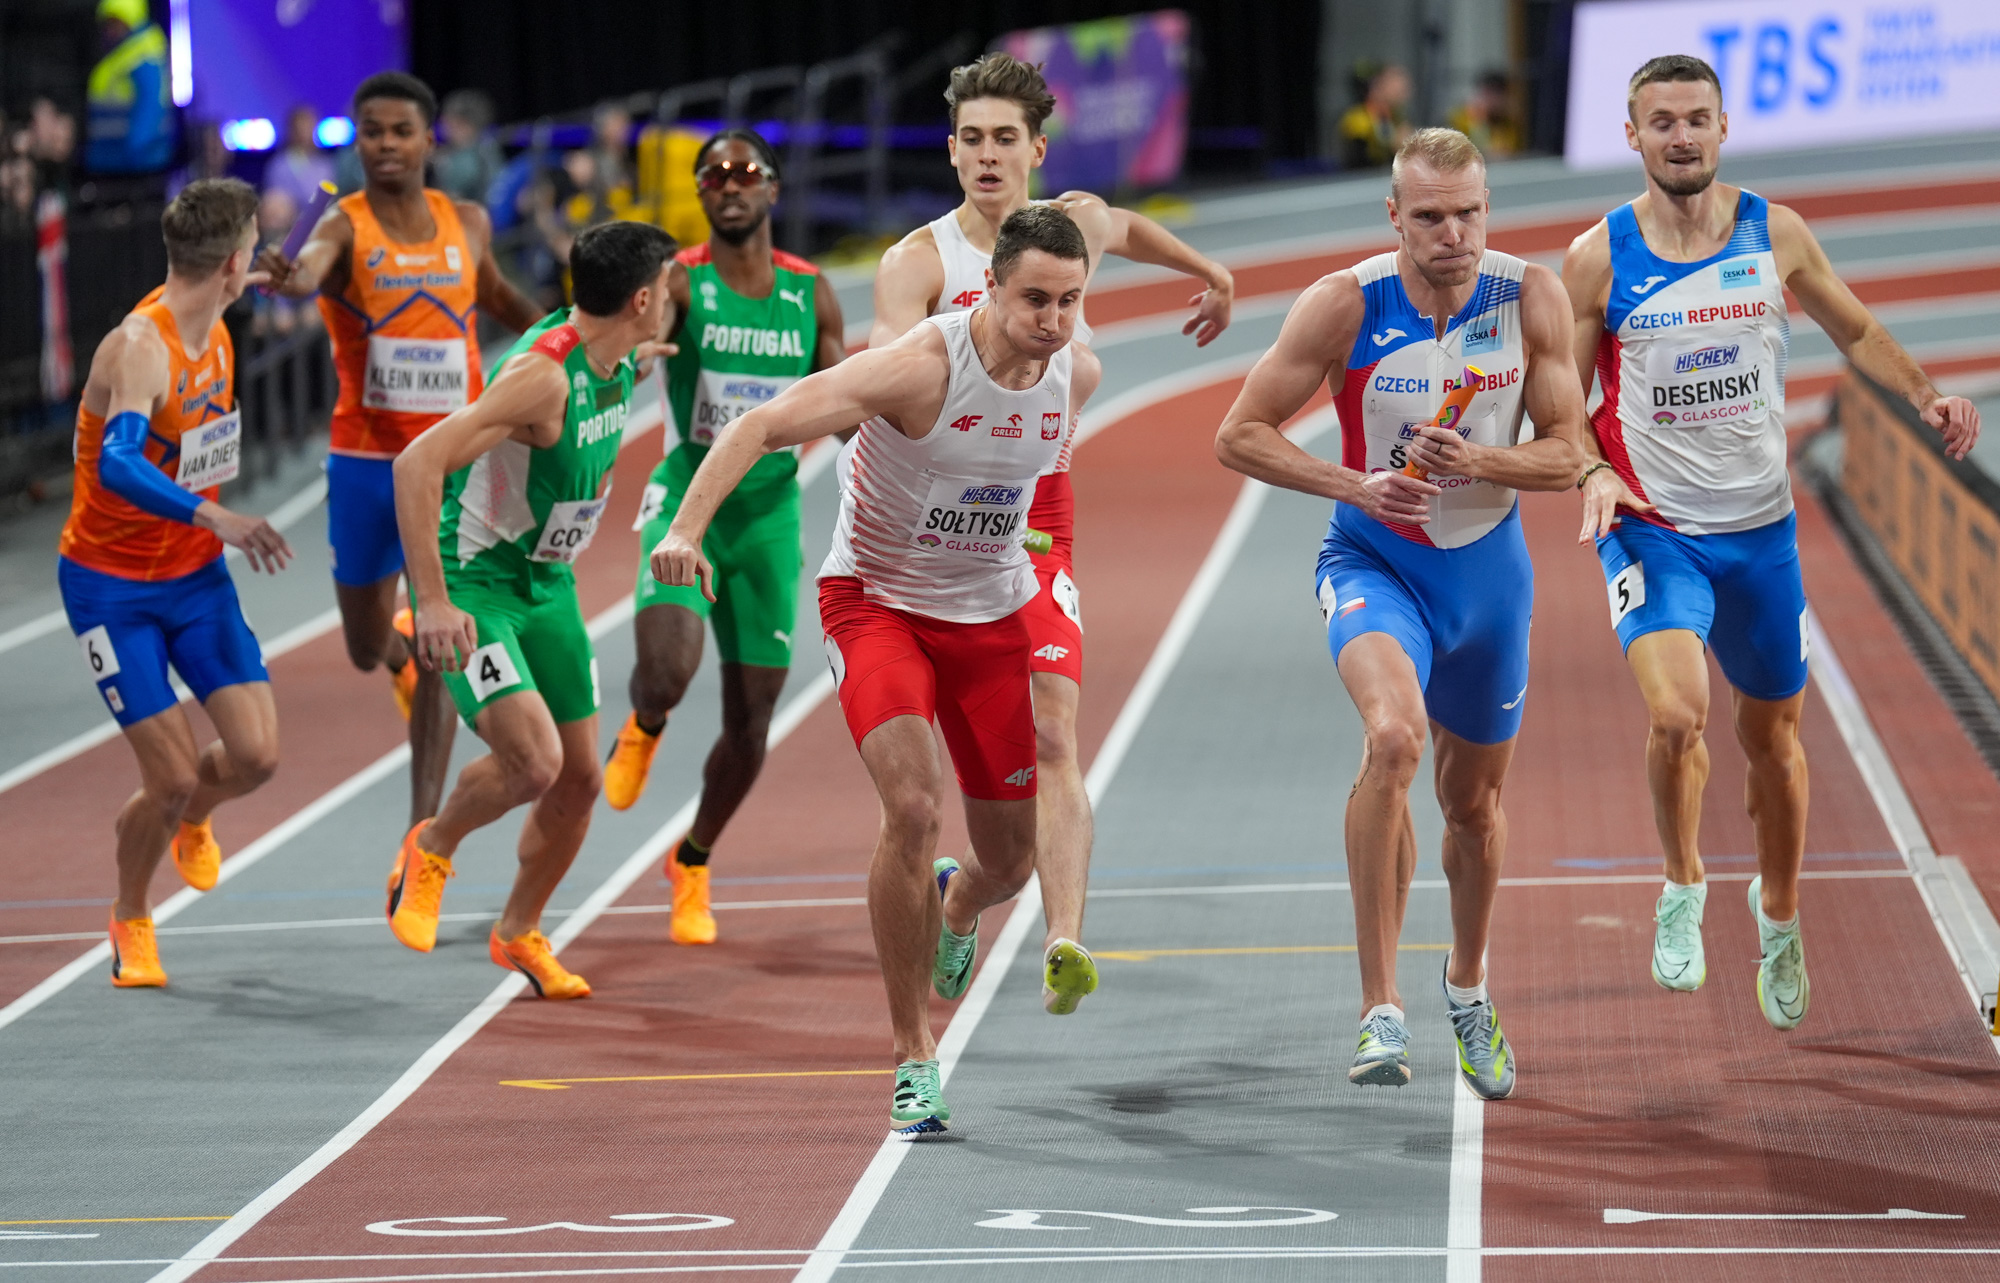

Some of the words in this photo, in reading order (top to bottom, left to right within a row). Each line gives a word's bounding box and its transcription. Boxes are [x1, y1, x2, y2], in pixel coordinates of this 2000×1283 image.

[1702, 16, 1842, 116] TBS
[952, 291, 983, 307] 4F
[1629, 312, 1683, 330] CZECH
[1688, 302, 1766, 324] REPUBLIC
[701, 323, 804, 357] PORTUGAL
[1466, 329, 1489, 342] ČESKÁ
[370, 366, 412, 390] KLEIN
[418, 371, 462, 392] IKKINK
[1375, 376, 1429, 393] CZECH
[1443, 367, 1519, 394] RUBLIC
[1653, 365, 1760, 407] DESENSKÝ
[697, 401, 729, 426] DOS
[950, 415, 983, 431] 4F
[1682, 402, 1750, 422] GLASGOW
[1753, 400, 1765, 410] 24
[577, 402, 628, 449] PORTUG
[993, 428, 1020, 438] ORLEN
[183, 454, 208, 478] VAN
[1390, 444, 1407, 469] Š
[926, 507, 1022, 537] SOŁTYSIA
[550, 527, 584, 547] CO
[946, 540, 1007, 554] GLASGOW
[1618, 576, 1630, 614] 5
[88, 639, 104, 673] 6
[1034, 643, 1069, 662] 4F
[481, 654, 501, 683] 4
[1004, 765, 1035, 786] 4F
[365, 1212, 736, 1237] 3
[1602, 1207, 1966, 1224] 1
